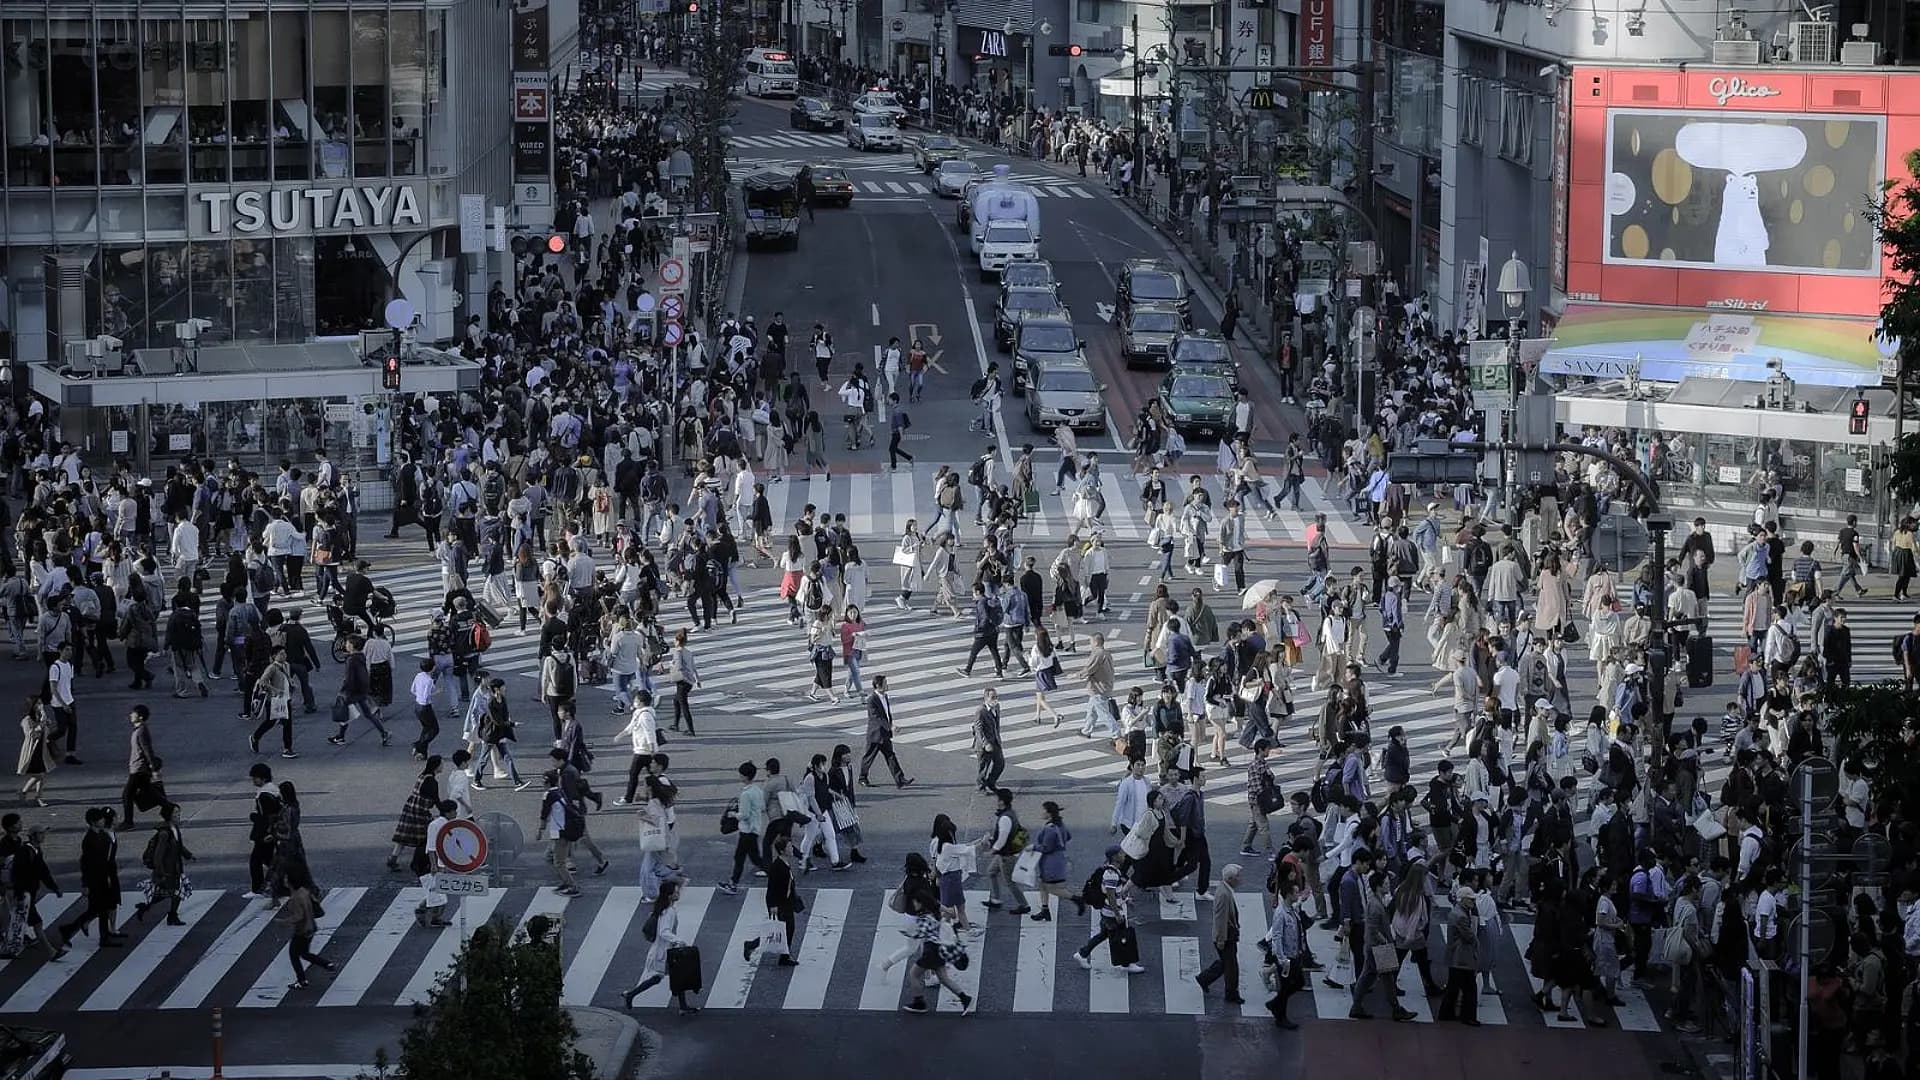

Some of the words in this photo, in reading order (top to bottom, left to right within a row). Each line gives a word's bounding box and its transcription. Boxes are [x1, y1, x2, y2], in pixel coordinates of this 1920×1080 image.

[981, 31, 1006, 56] ZARA
[520, 92, 543, 114] 本
[1709, 77, 1781, 106] Glico
[200, 185, 422, 233] TSUTAYA
[440, 880, 484, 892] ここから
